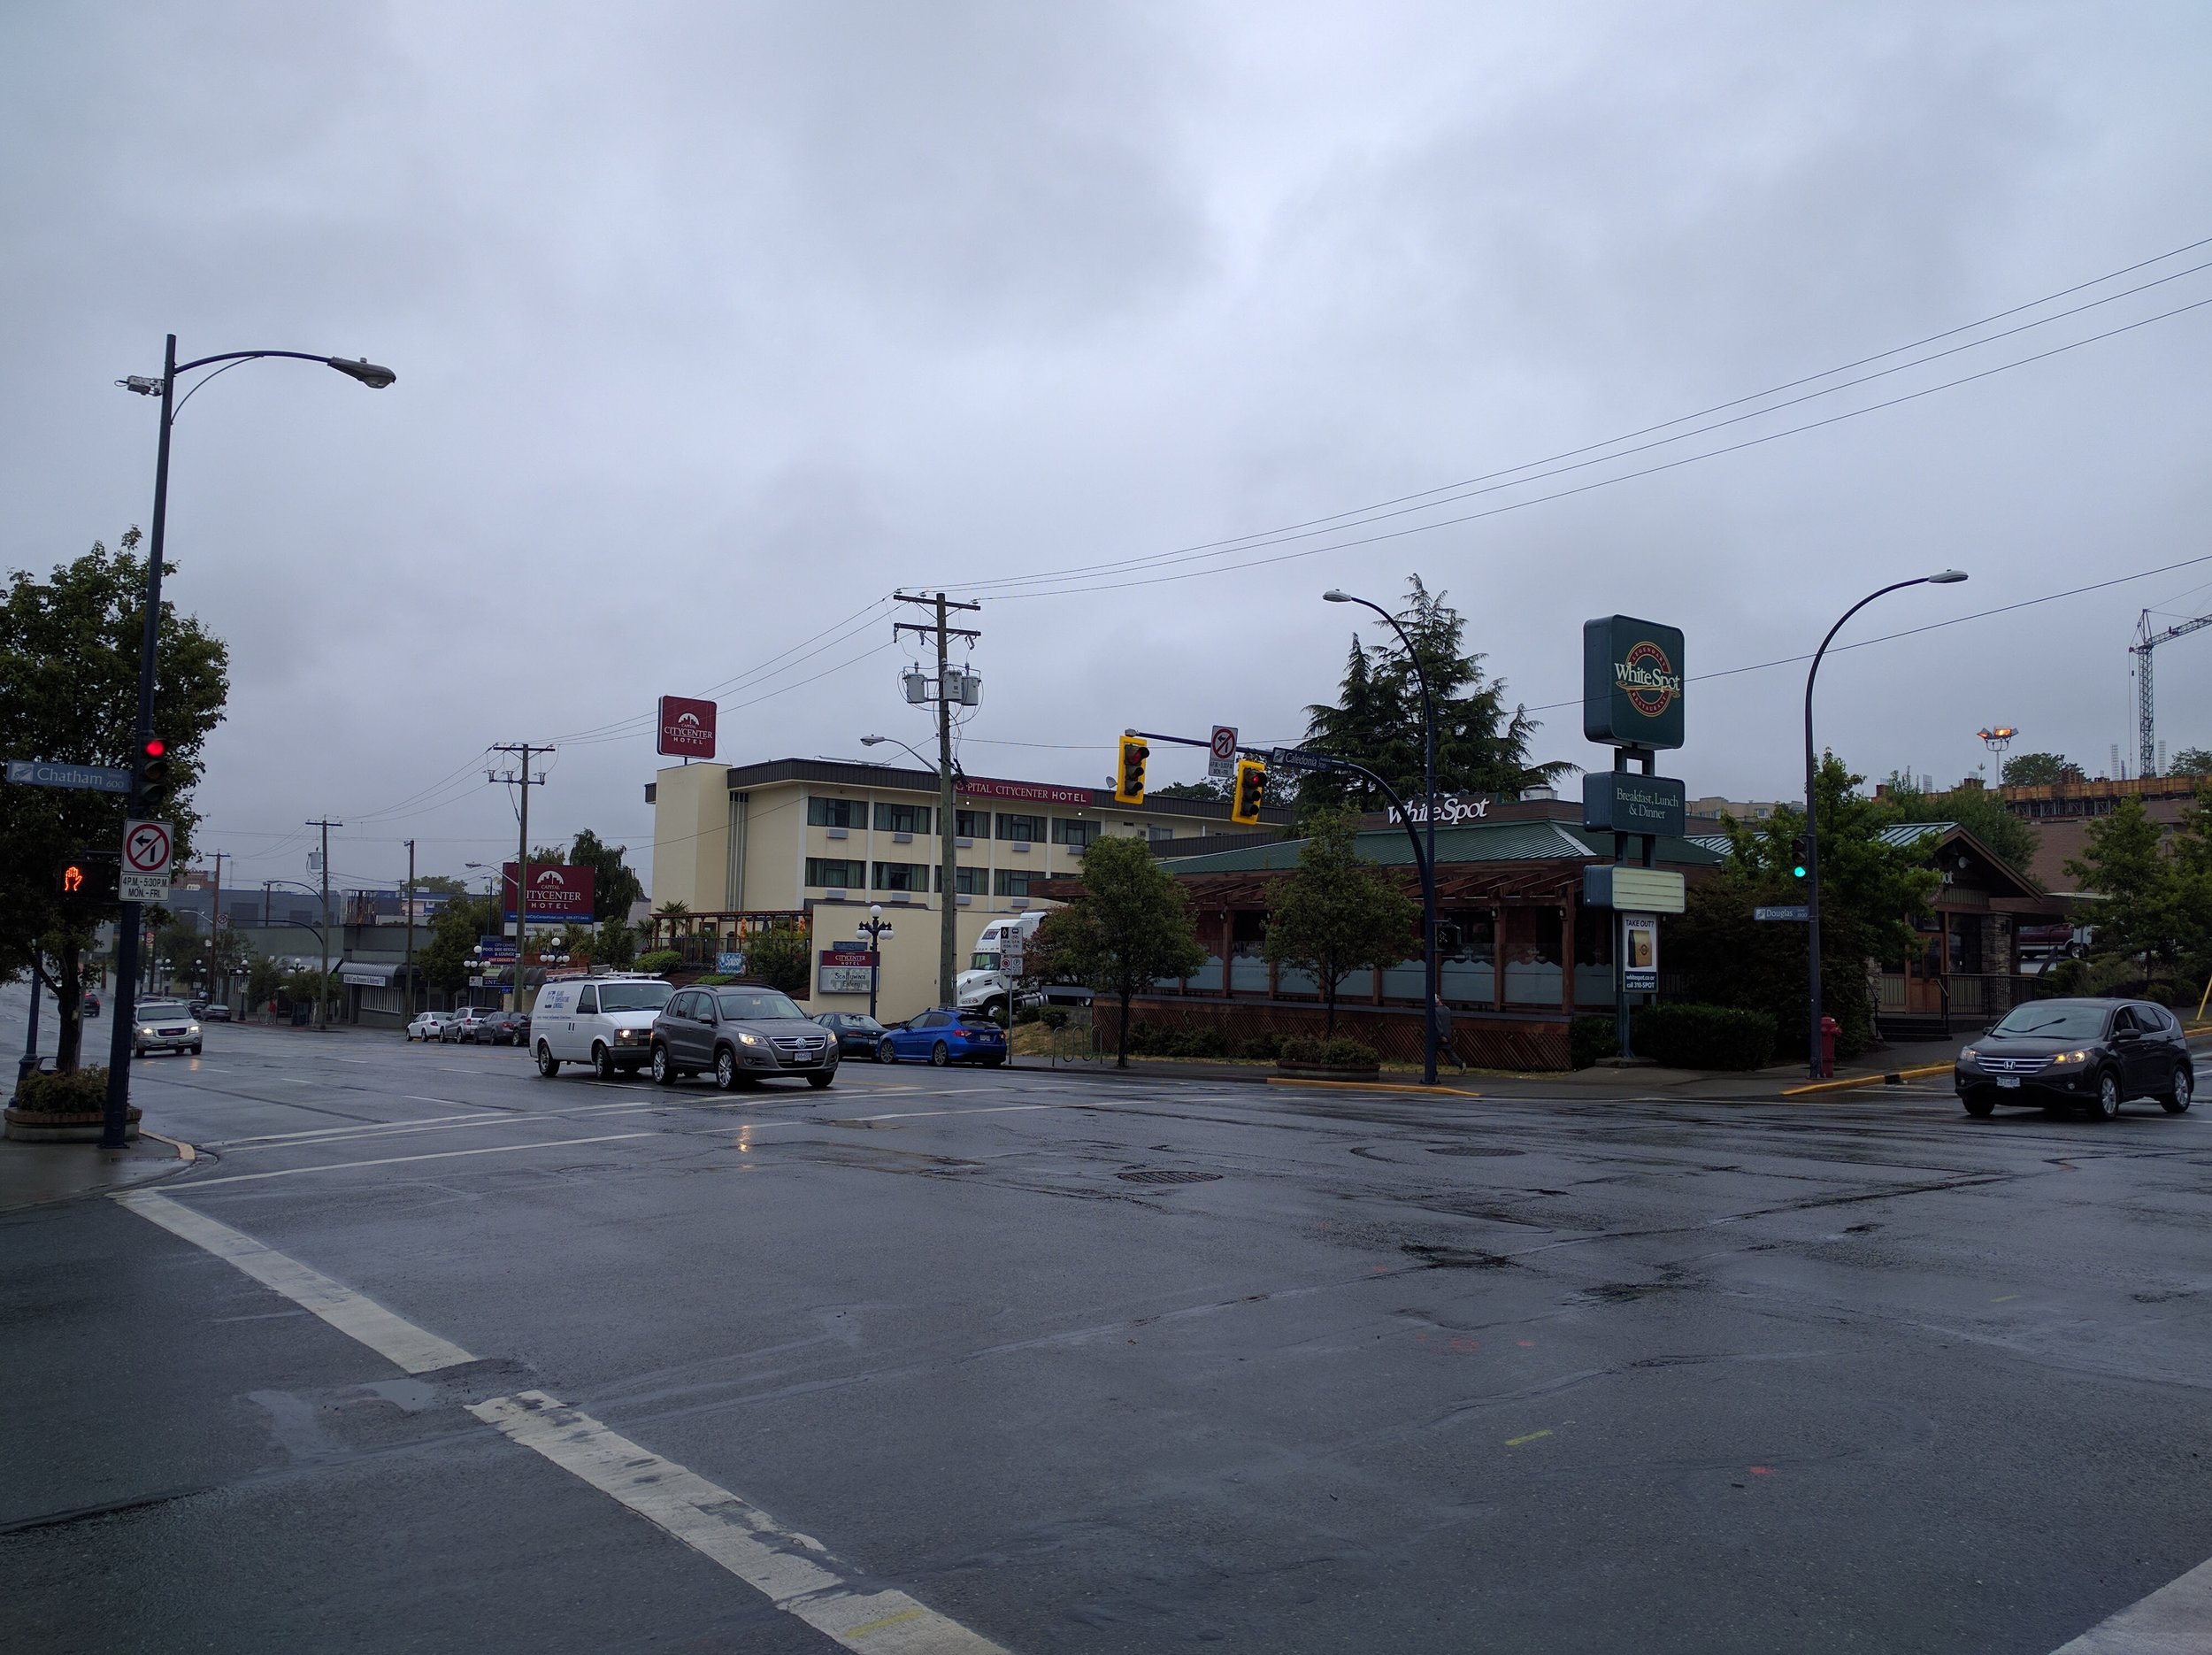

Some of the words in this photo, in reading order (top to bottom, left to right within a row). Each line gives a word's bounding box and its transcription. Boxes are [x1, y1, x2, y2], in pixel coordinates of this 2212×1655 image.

[664, 726, 713, 739] CITYCENTER
[673, 736, 703, 745] HOTEL
[1285, 752, 1317, 766] Caledonia
[36, 767, 103, 785] Chatham
[105, 780, 124, 789] 600
[956, 781, 992, 794] CPITAL
[995, 785, 1048, 799] CITYCENTER
[1051, 790, 1087, 803] HOTEL
[1616, 787, 1654, 805] Breakfast,
[1655, 792, 1679, 807] Lunch
[1629, 803, 1638, 816] &
[1639, 804, 1665, 819] Dinner
[526, 889, 581, 901] ITYCENTER
[1766, 909, 1793, 918] Douglas
[1625, 919, 1640, 928] TAKE
